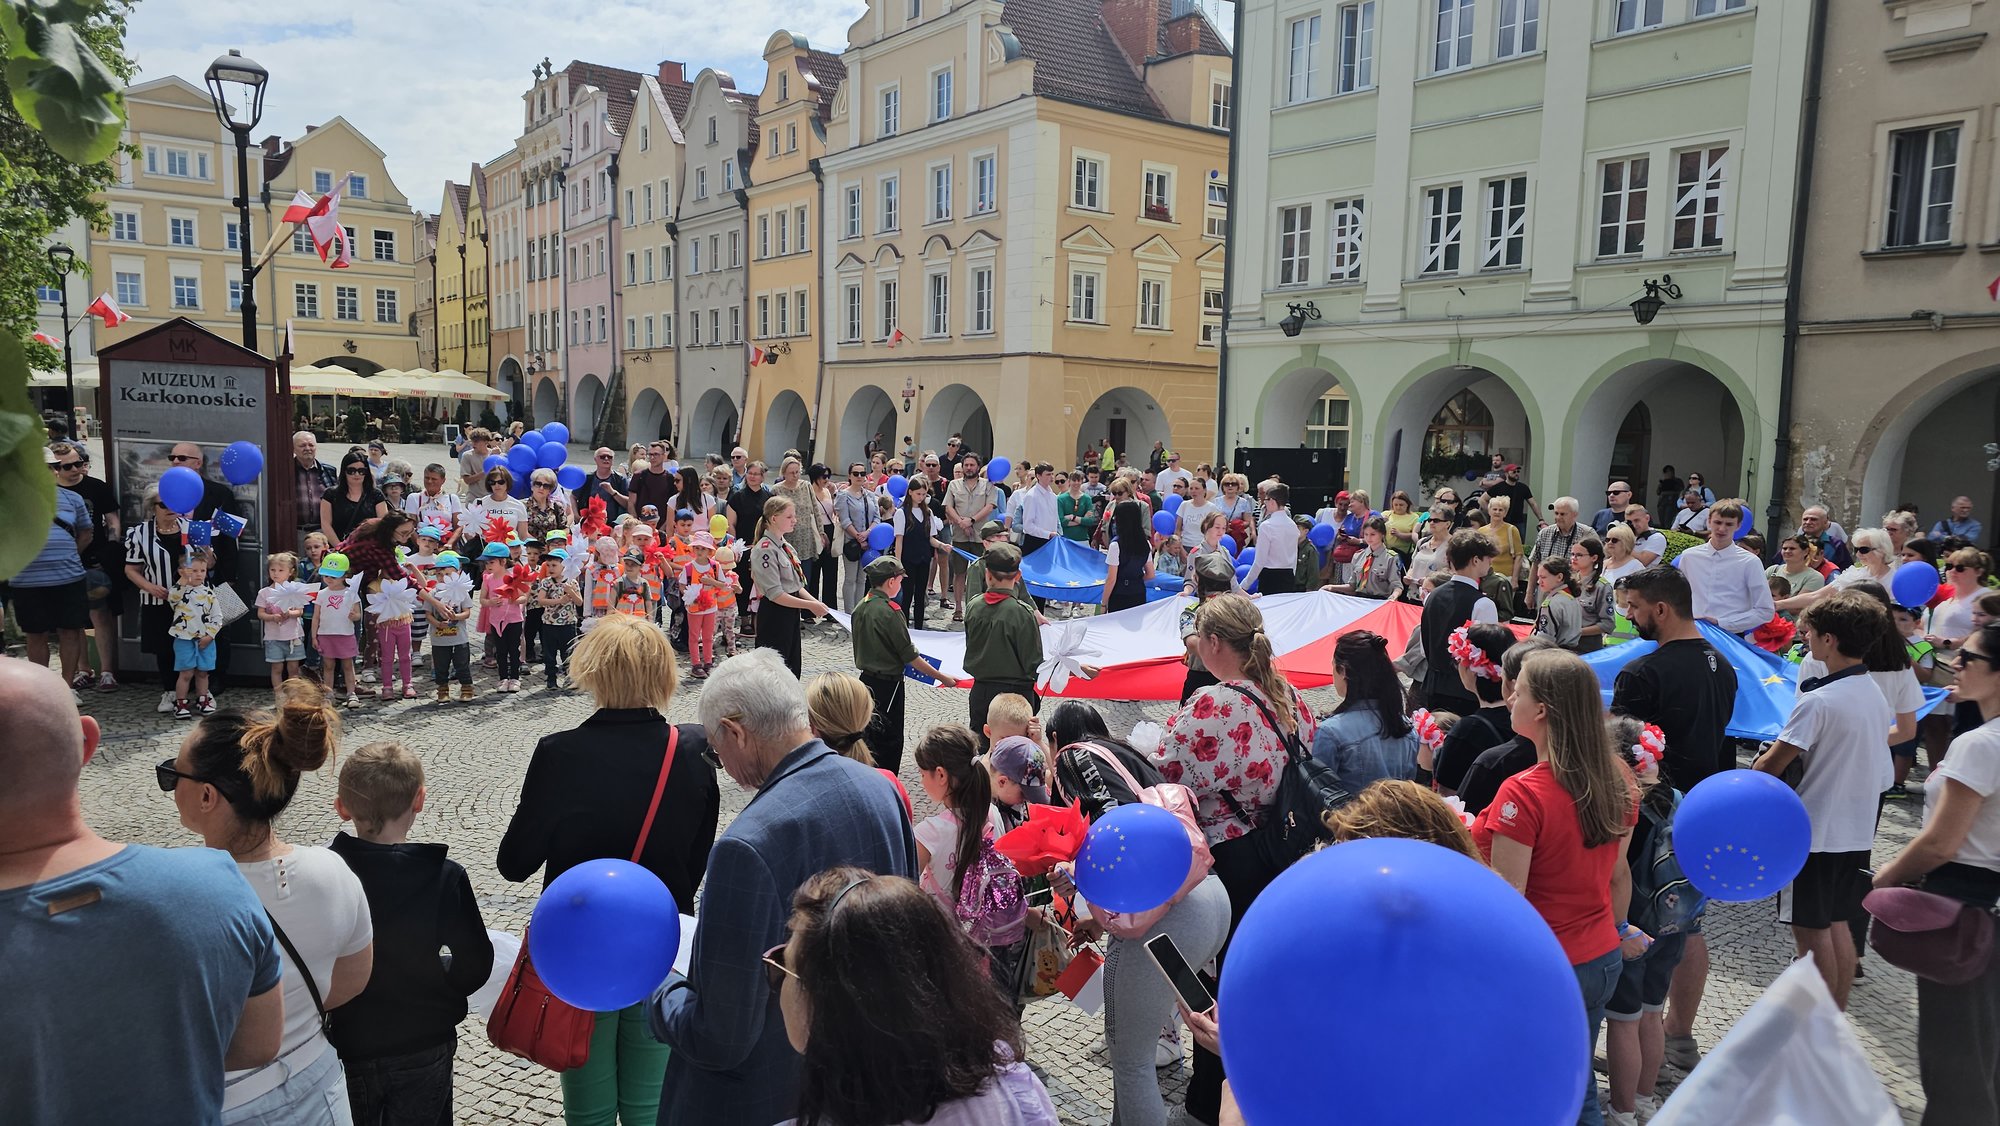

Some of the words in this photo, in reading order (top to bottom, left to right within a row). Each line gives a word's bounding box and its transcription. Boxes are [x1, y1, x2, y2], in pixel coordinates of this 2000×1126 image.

[1331, 206, 1363, 274] B
[169, 337, 197, 352] MK
[141, 371, 216, 389] MUZEUM
[120, 386, 257, 408] Karkonoskie
